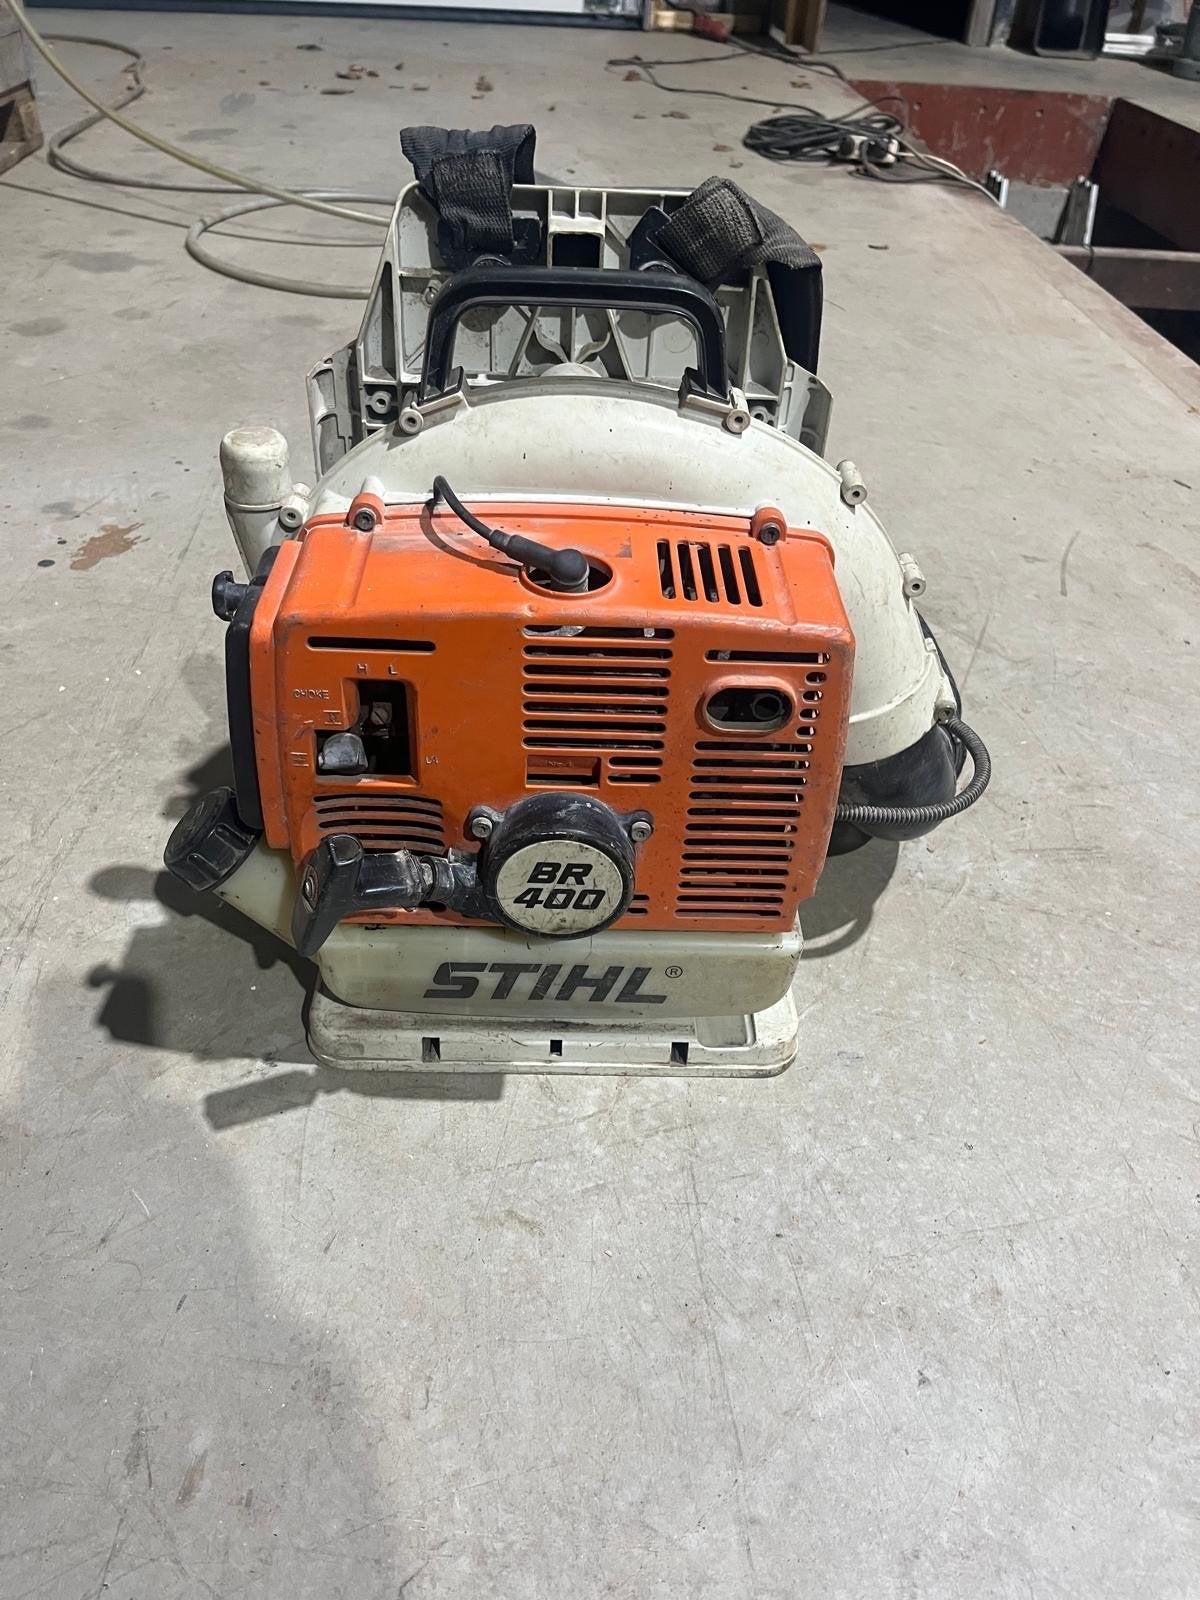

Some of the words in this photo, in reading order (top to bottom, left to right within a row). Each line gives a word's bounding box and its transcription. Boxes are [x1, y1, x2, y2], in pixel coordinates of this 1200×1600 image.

[356, 663, 368, 674] H
[388, 664, 399, 675] L
[292, 688, 330, 700] CHOKE
[527, 861, 593, 886] BR
[513, 887, 606, 910] 400
[423, 961, 668, 1004] STIHL
